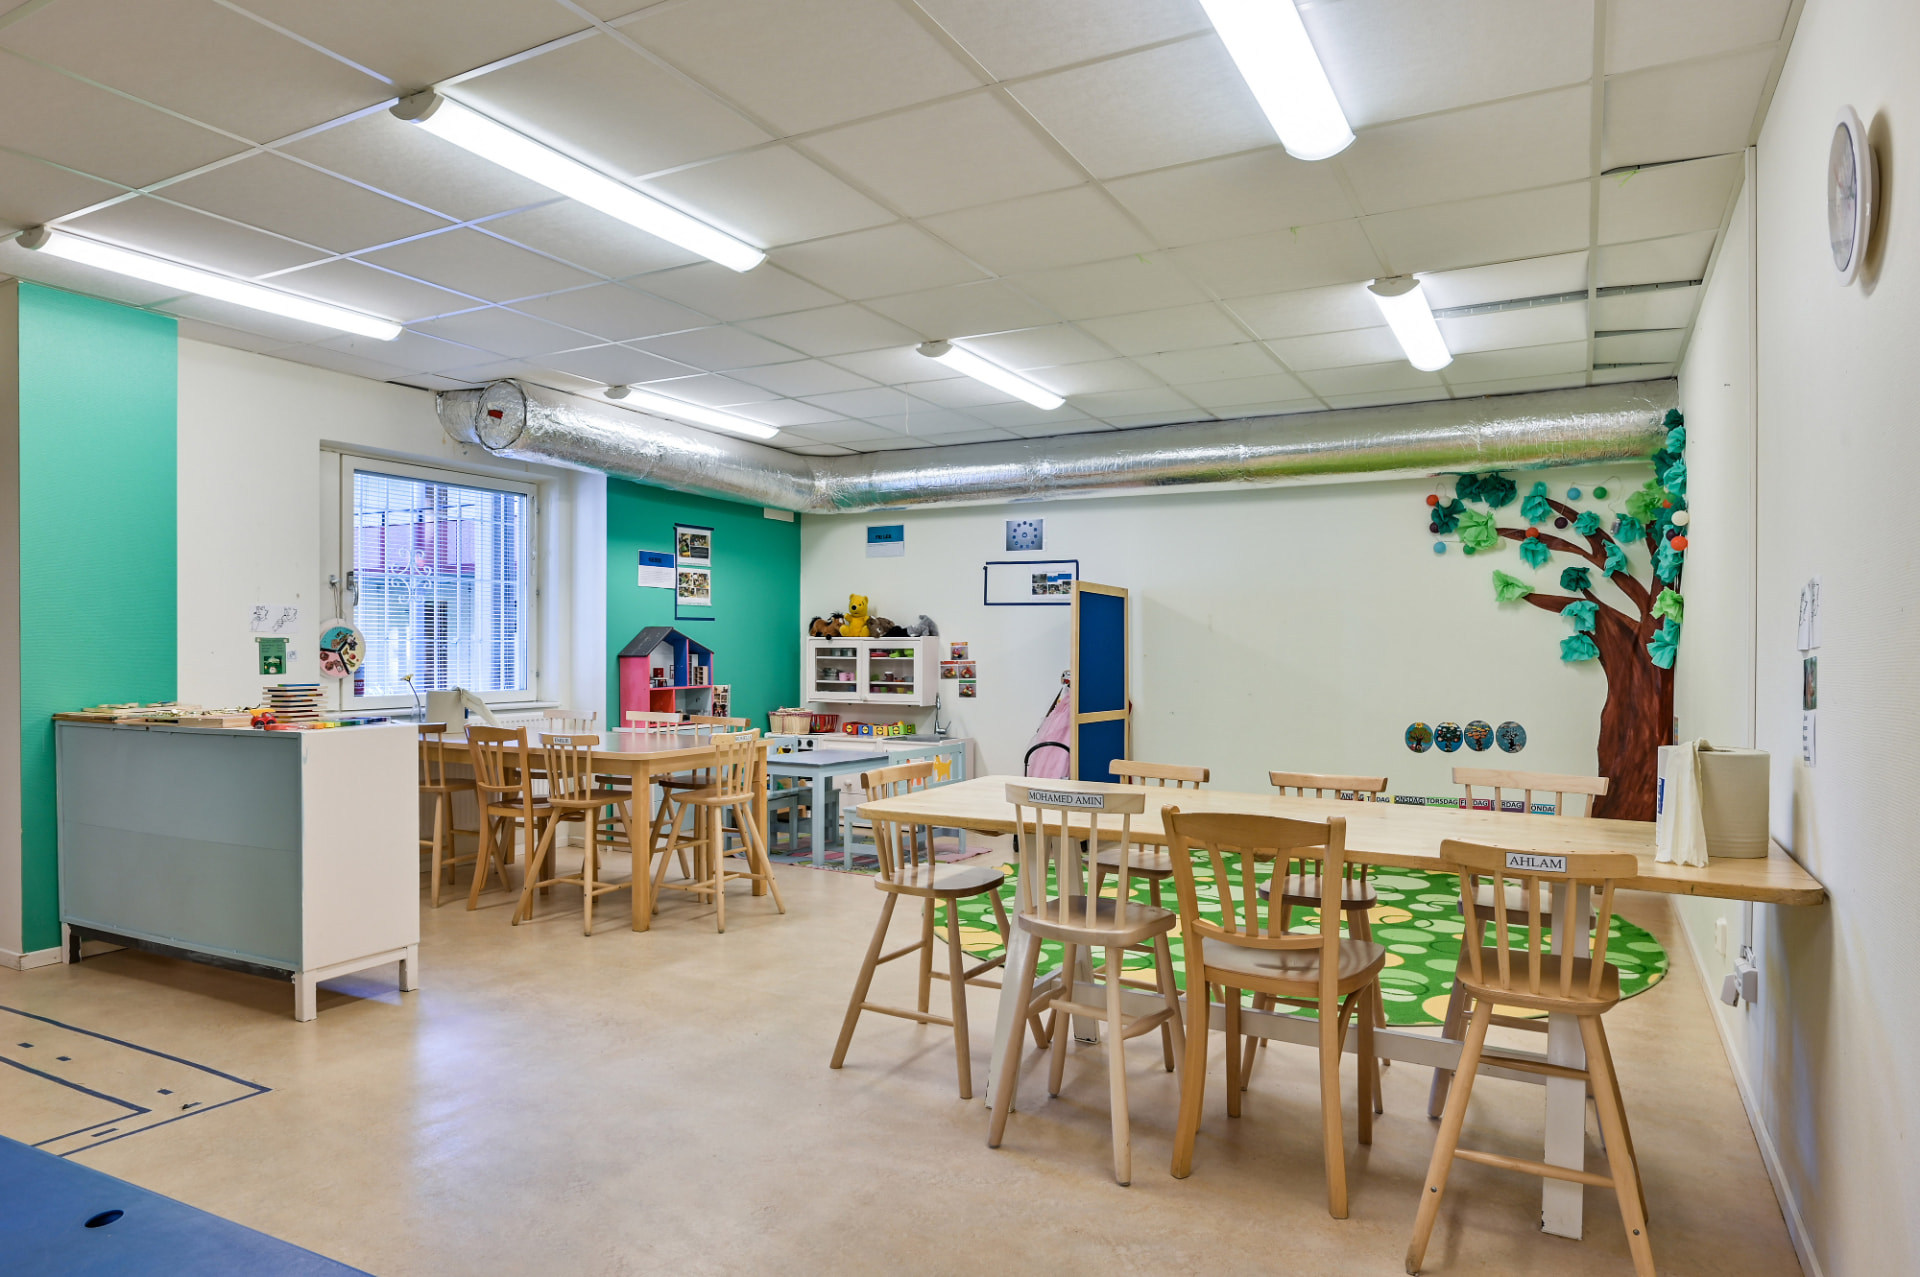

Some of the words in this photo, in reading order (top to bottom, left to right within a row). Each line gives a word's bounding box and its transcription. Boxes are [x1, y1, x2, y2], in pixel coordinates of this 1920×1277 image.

[1029, 792, 1073, 804] MOHAMED
[1075, 795, 1102, 805] AMIN
[1395, 796, 1425, 804] ONSDAG
[1426, 797, 1458, 805] TORSDAG
[1509, 855, 1562, 869] AHLAM
